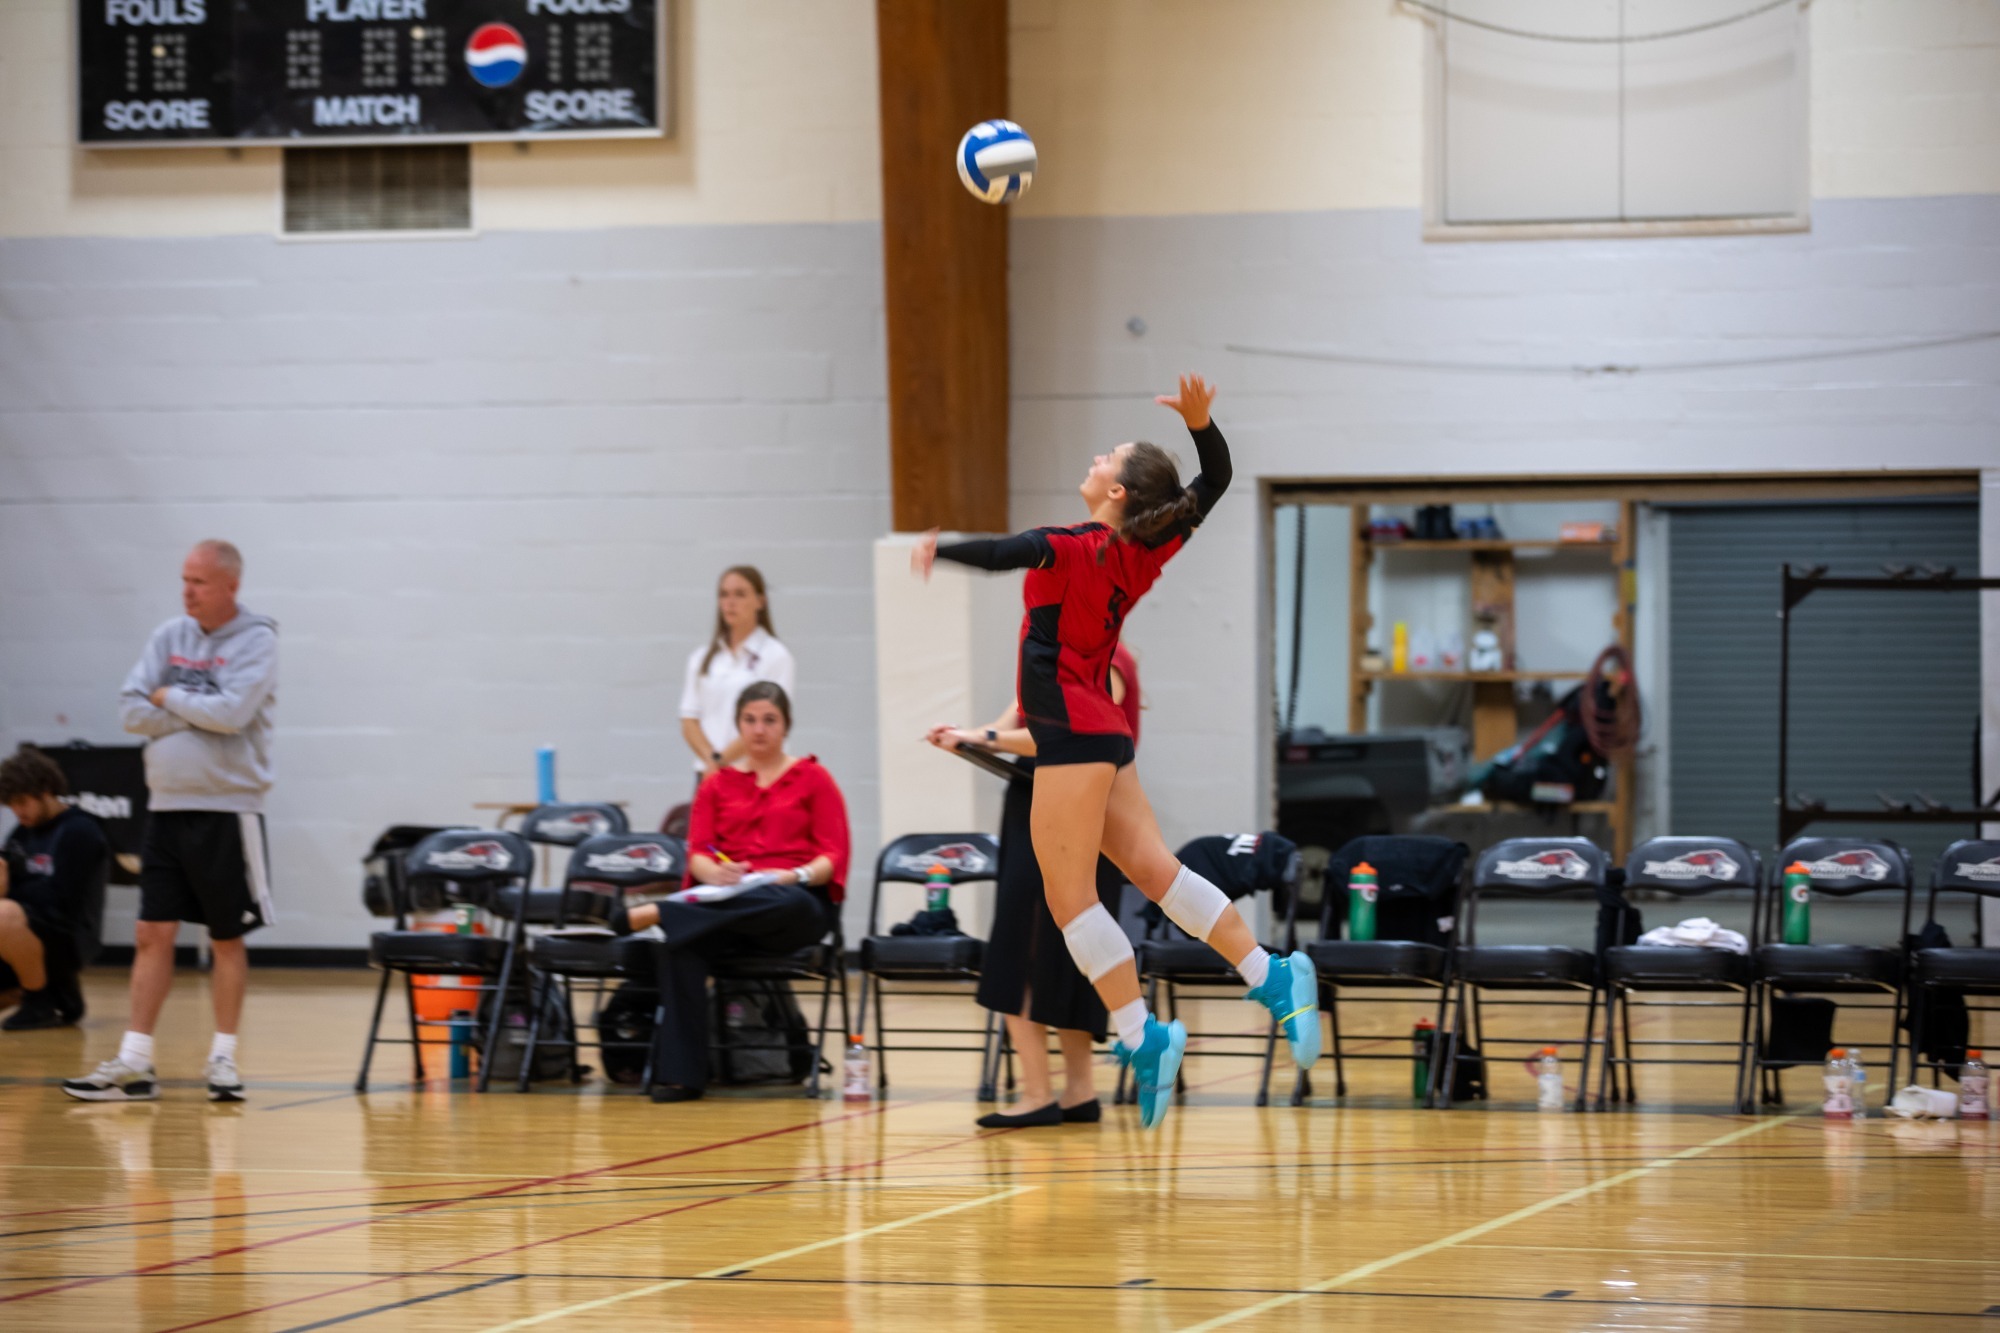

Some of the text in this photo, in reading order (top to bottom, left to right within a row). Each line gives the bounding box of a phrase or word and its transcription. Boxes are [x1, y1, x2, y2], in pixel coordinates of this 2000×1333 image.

[106, 0, 207, 25] FOULS
[306, 0, 427, 21] PLAYER
[104, 98, 210, 130] SCORE
[313, 94, 420, 125] MATCH
[524, 88, 634, 121] SCORE
[1791, 884, 1809, 903] G
